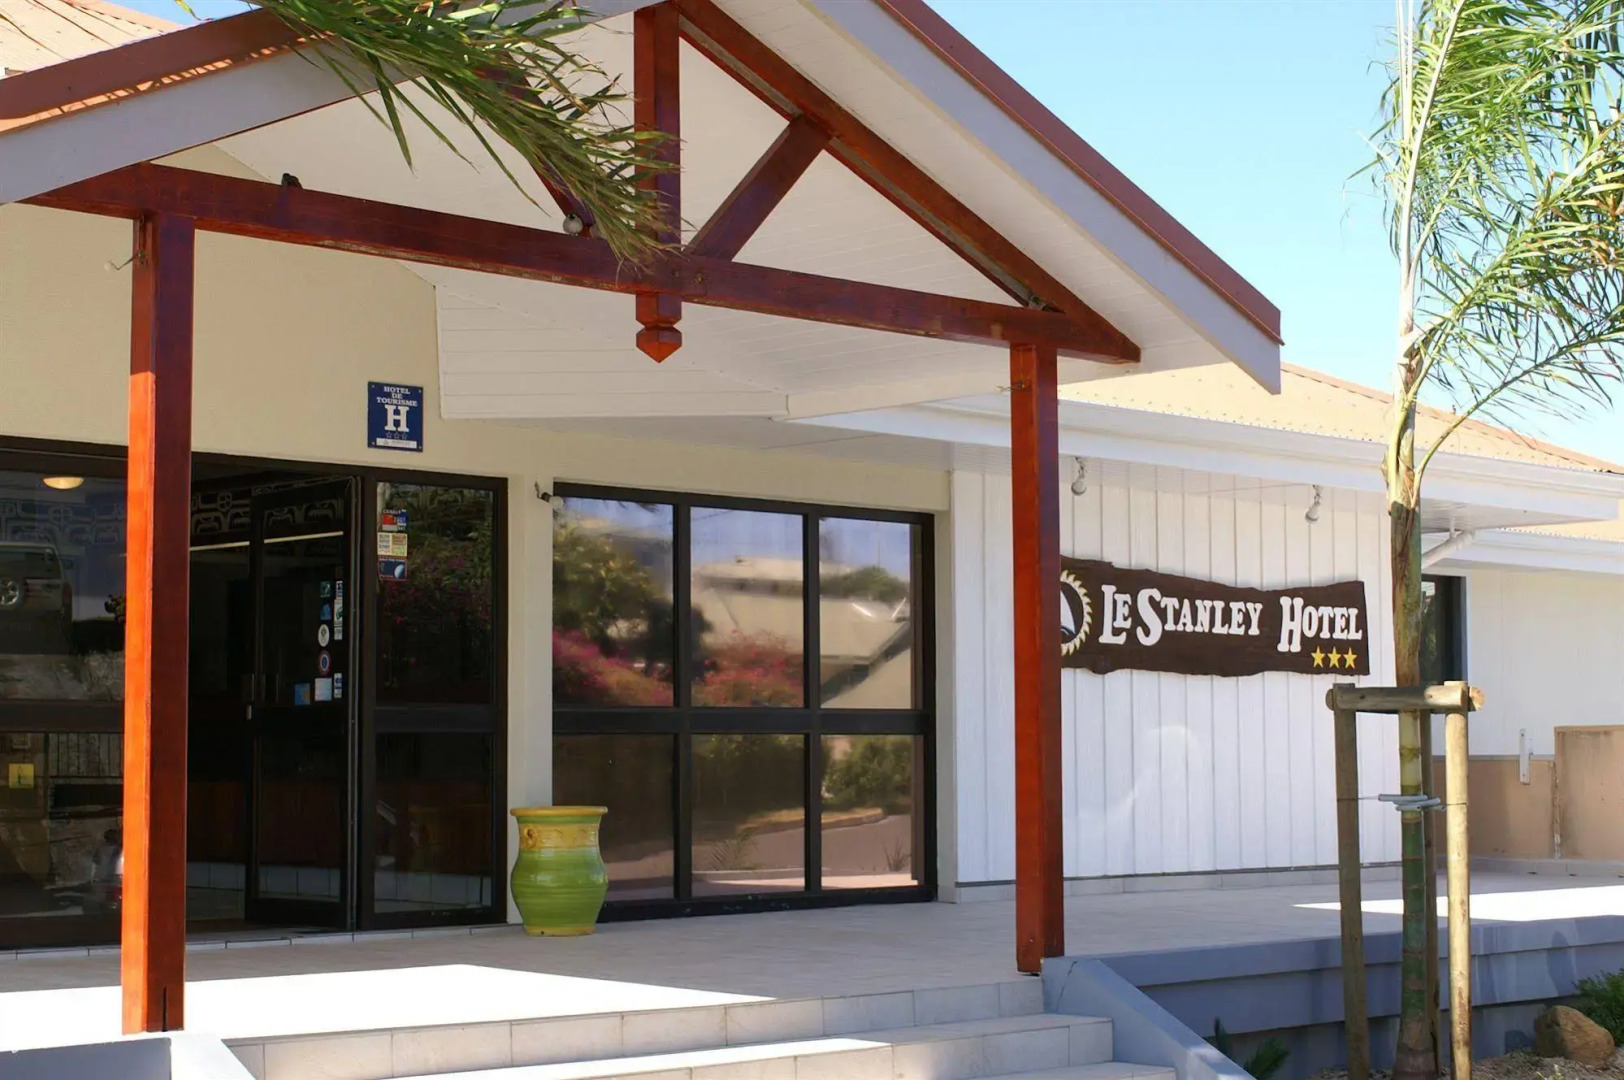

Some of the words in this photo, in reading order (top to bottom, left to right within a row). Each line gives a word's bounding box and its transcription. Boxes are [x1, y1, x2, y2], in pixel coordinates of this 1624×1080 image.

[384, 386, 411, 394] HOTEL
[376, 397, 418, 407] TOURISME
[384, 404, 410, 432] H
[1098, 584, 1133, 646] LE
[1136, 587, 1263, 647] STANLEY
[1277, 596, 1363, 653] HOTEL
